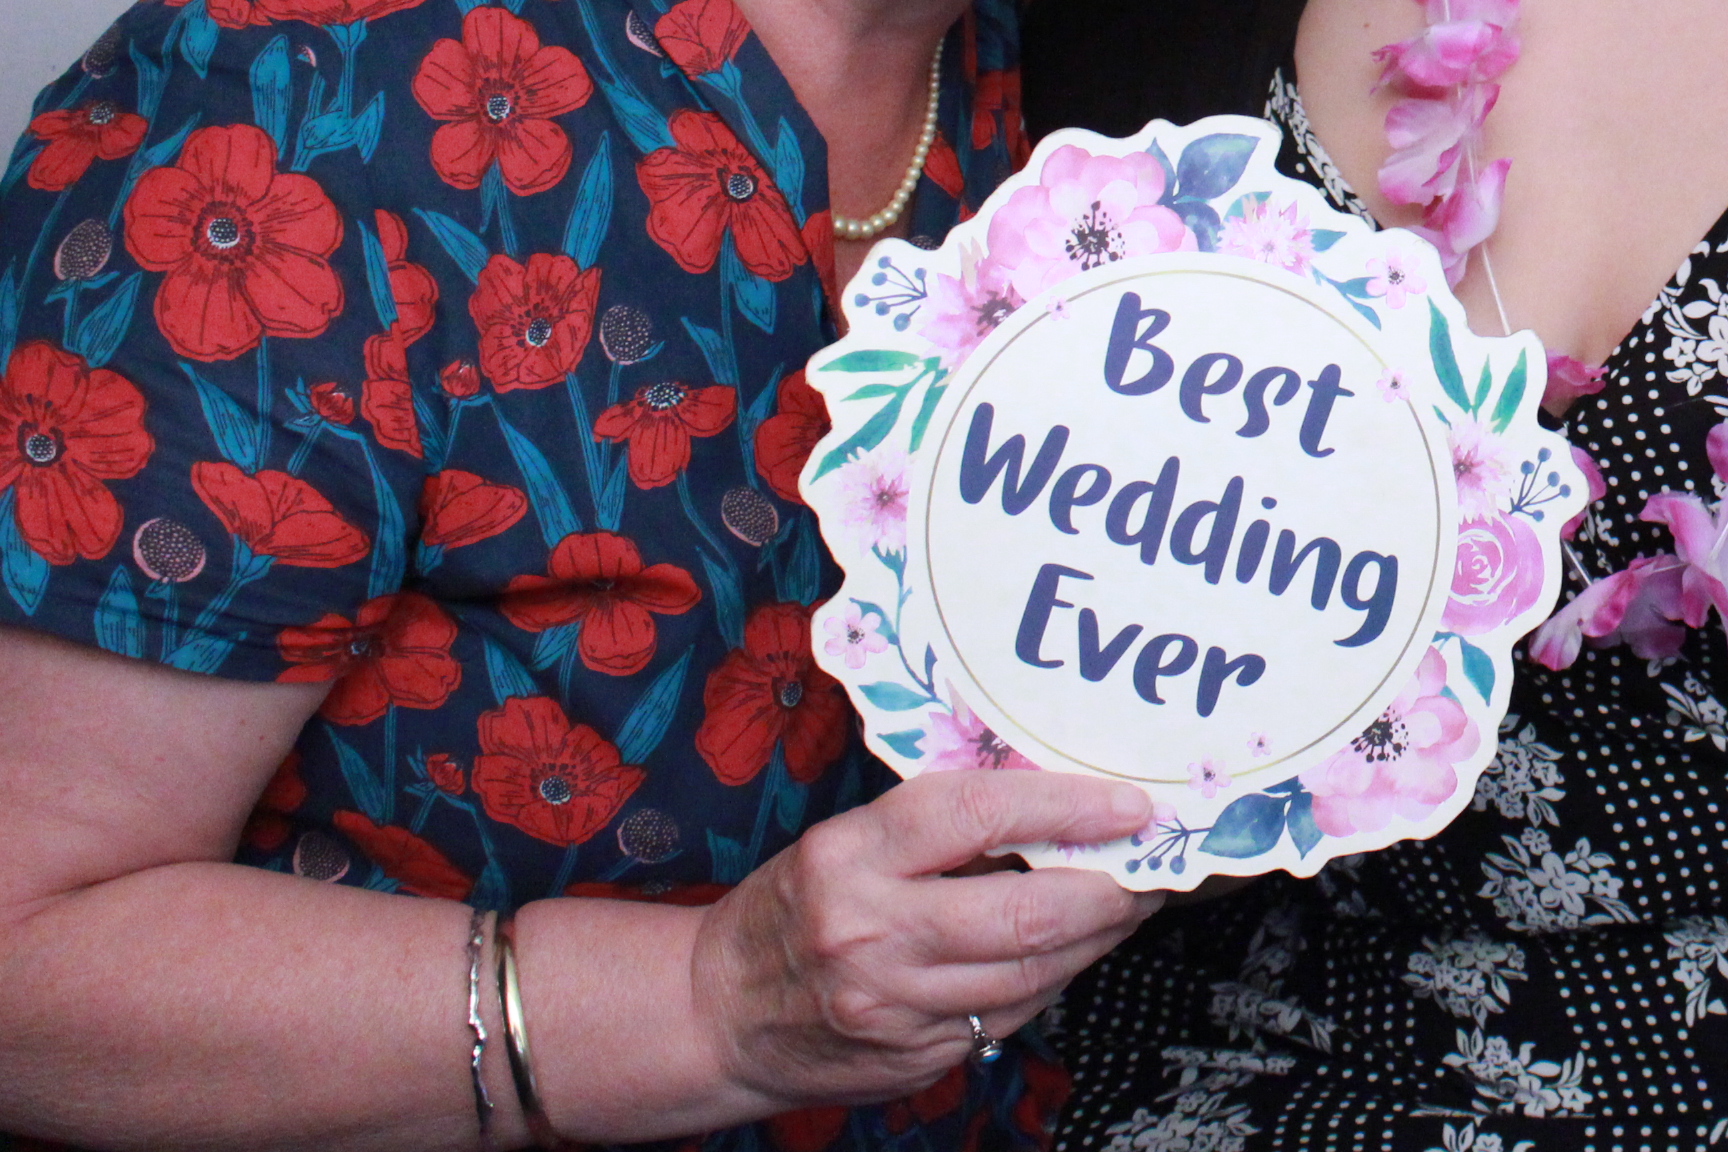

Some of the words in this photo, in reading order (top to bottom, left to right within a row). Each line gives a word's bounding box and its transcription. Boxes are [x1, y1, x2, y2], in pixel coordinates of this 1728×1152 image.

[1103, 291, 1355, 459] Best
[959, 402, 1399, 648] Wedding
[1014, 563, 1267, 718] Ever
